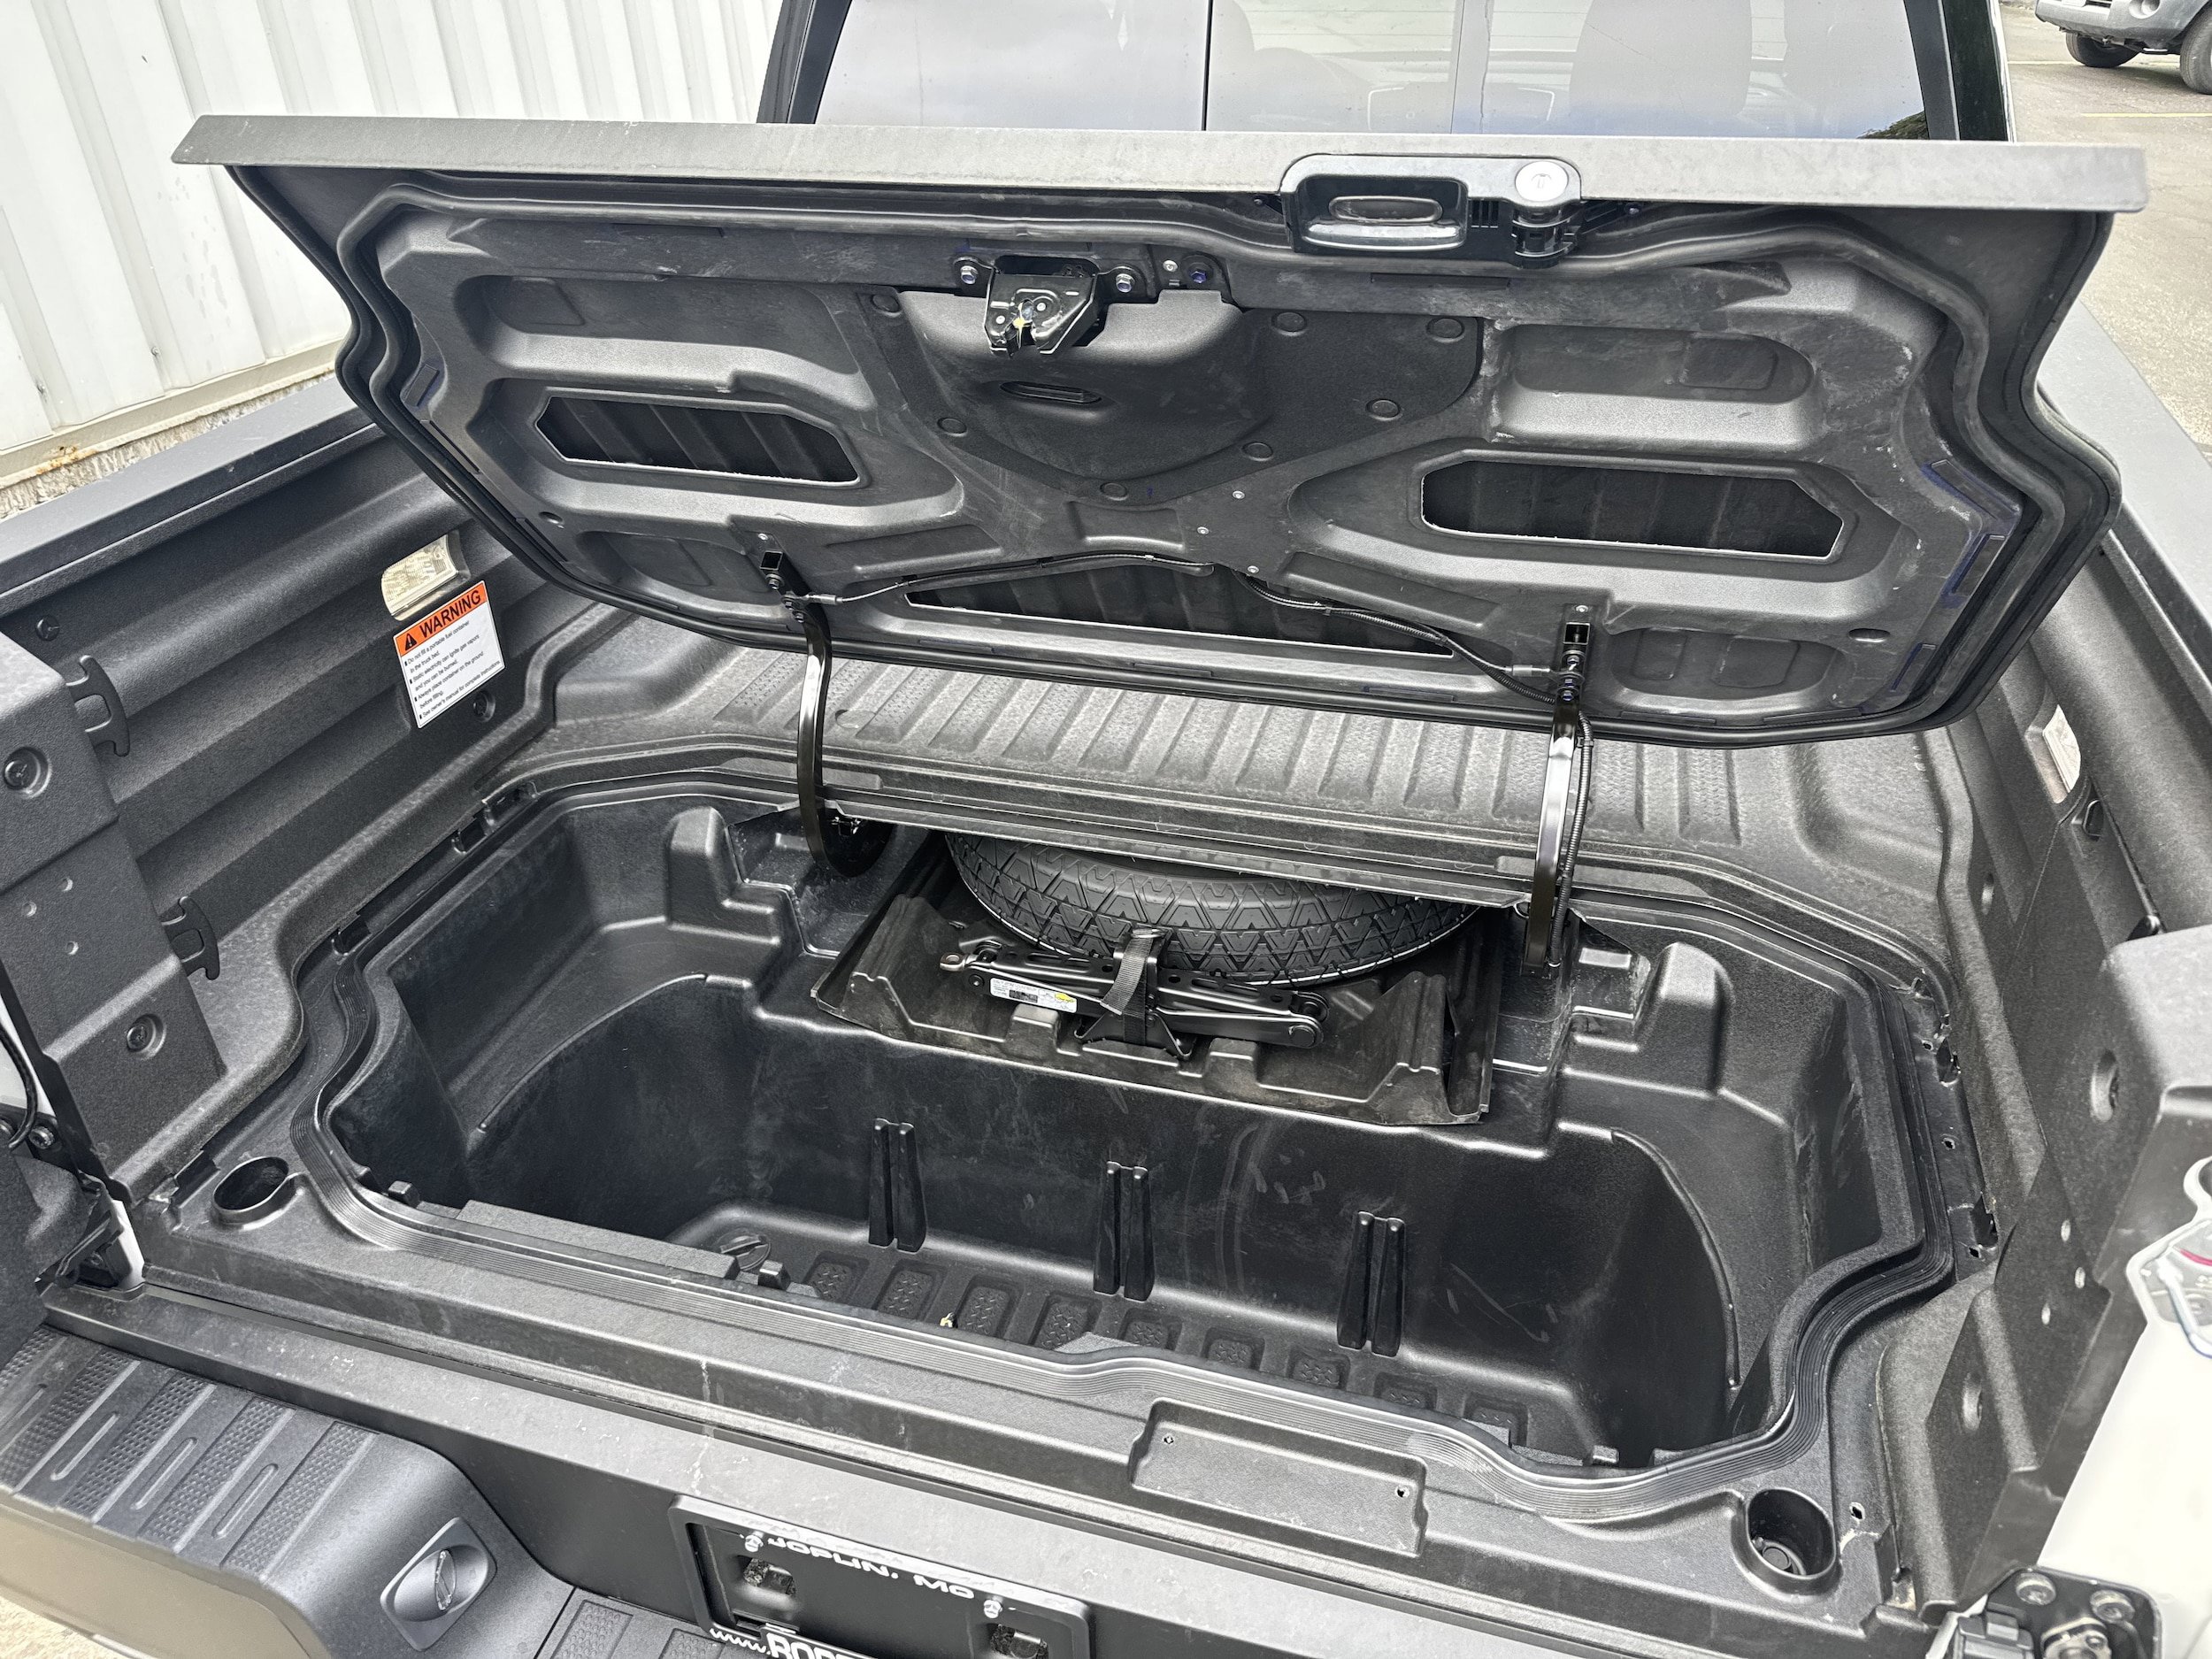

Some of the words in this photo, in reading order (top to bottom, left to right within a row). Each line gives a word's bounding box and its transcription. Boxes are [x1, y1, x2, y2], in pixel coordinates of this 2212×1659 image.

[419, 588, 480, 639] WARNING
[429, 635, 445, 650] portable
[452, 619, 469, 634] container
[412, 671, 423, 681] Static
[424, 658, 442, 675] electricity
[449, 647, 459, 658] ignite
[417, 686, 431, 700] Always
[431, 679, 442, 691] place
[442, 667, 458, 682] container
[471, 650, 483, 664] ground
[420, 656, 430, 665] truck
[445, 687, 458, 701] manual
[464, 672, 480, 688] complete
[419, 696, 432, 709] before
[913, 1574, 974, 1599] MO
[710, 1628, 855, 1659] www.RO
